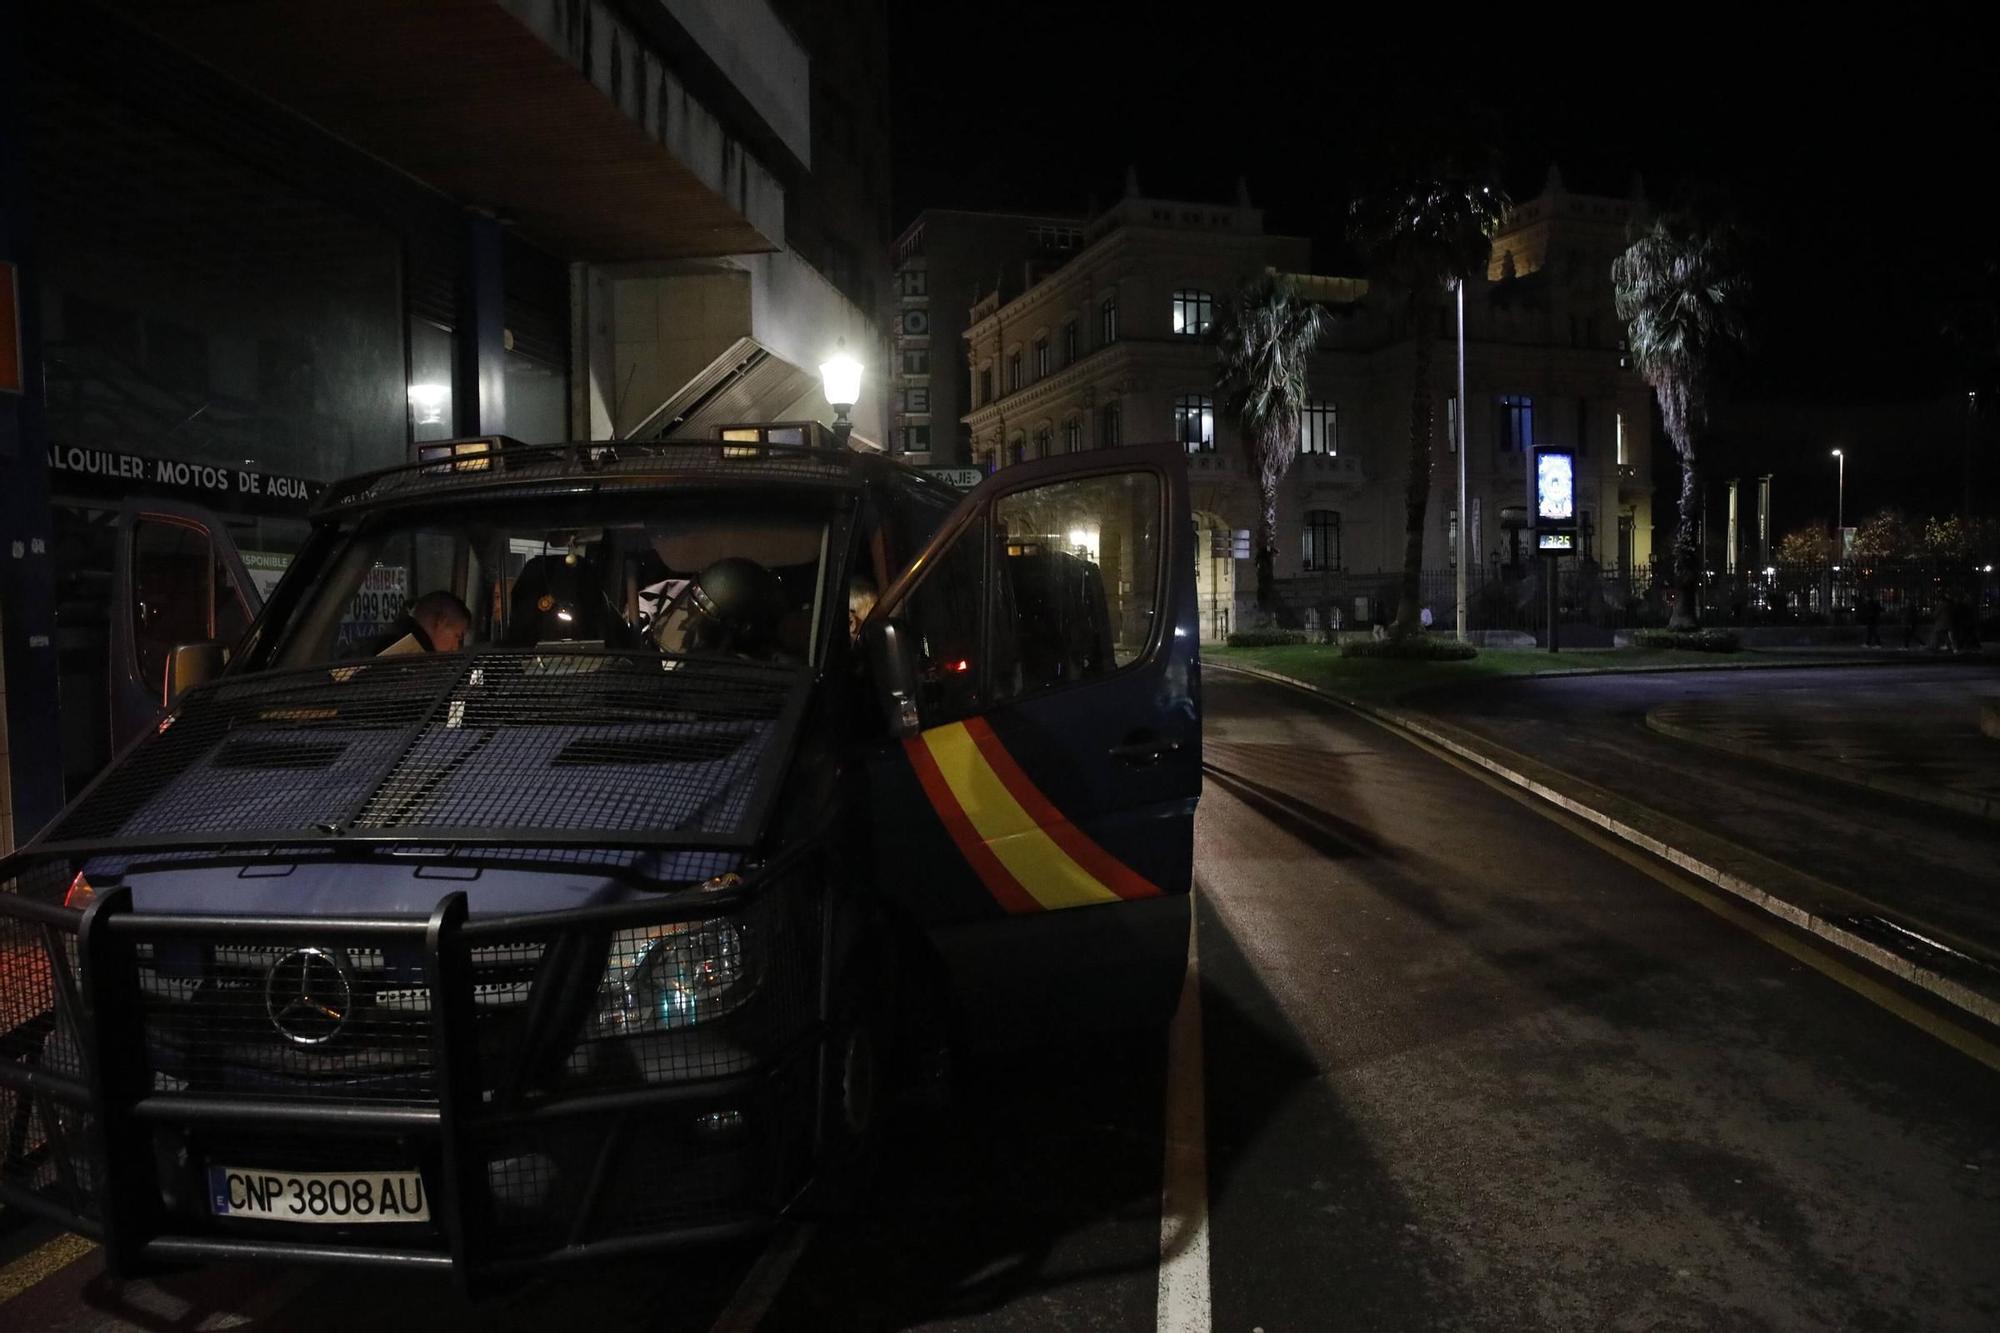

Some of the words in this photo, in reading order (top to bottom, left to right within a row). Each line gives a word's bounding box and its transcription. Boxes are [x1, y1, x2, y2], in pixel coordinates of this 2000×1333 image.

[903, 271, 929, 451] HOTEL
[156, 460, 229, 491] MOTOS
[238, 472, 261, 495] DE
[266, 476, 309, 500] AGUA
[216, 1195, 225, 1207] E
